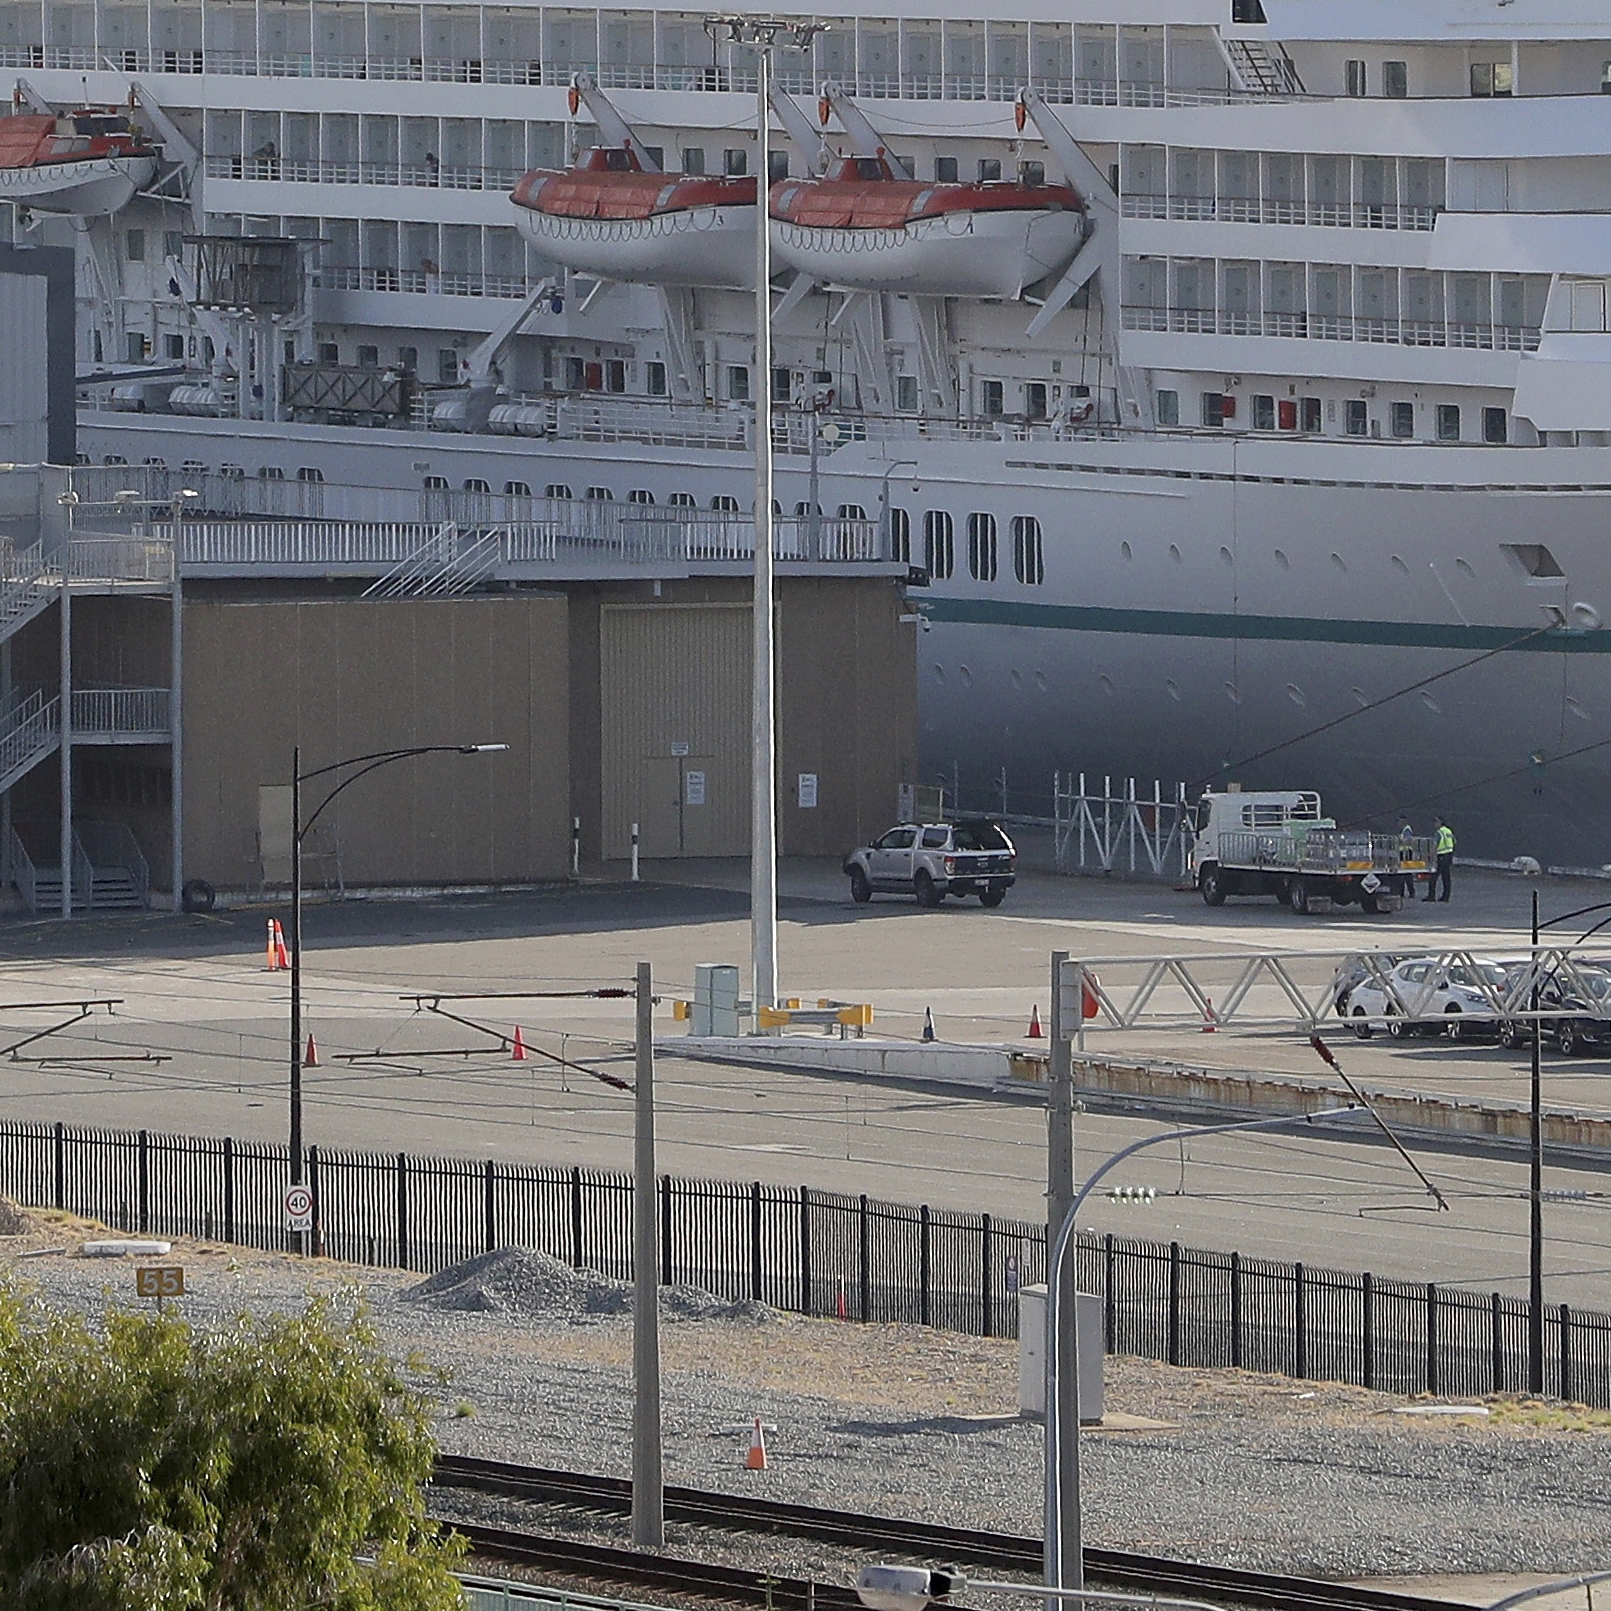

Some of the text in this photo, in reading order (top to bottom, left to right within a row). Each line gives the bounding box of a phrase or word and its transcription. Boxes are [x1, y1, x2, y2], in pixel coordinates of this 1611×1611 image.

[291, 1196, 308, 1209] 40
[287, 1218, 312, 1228] AREA
[143, 1270, 179, 1294] 55
